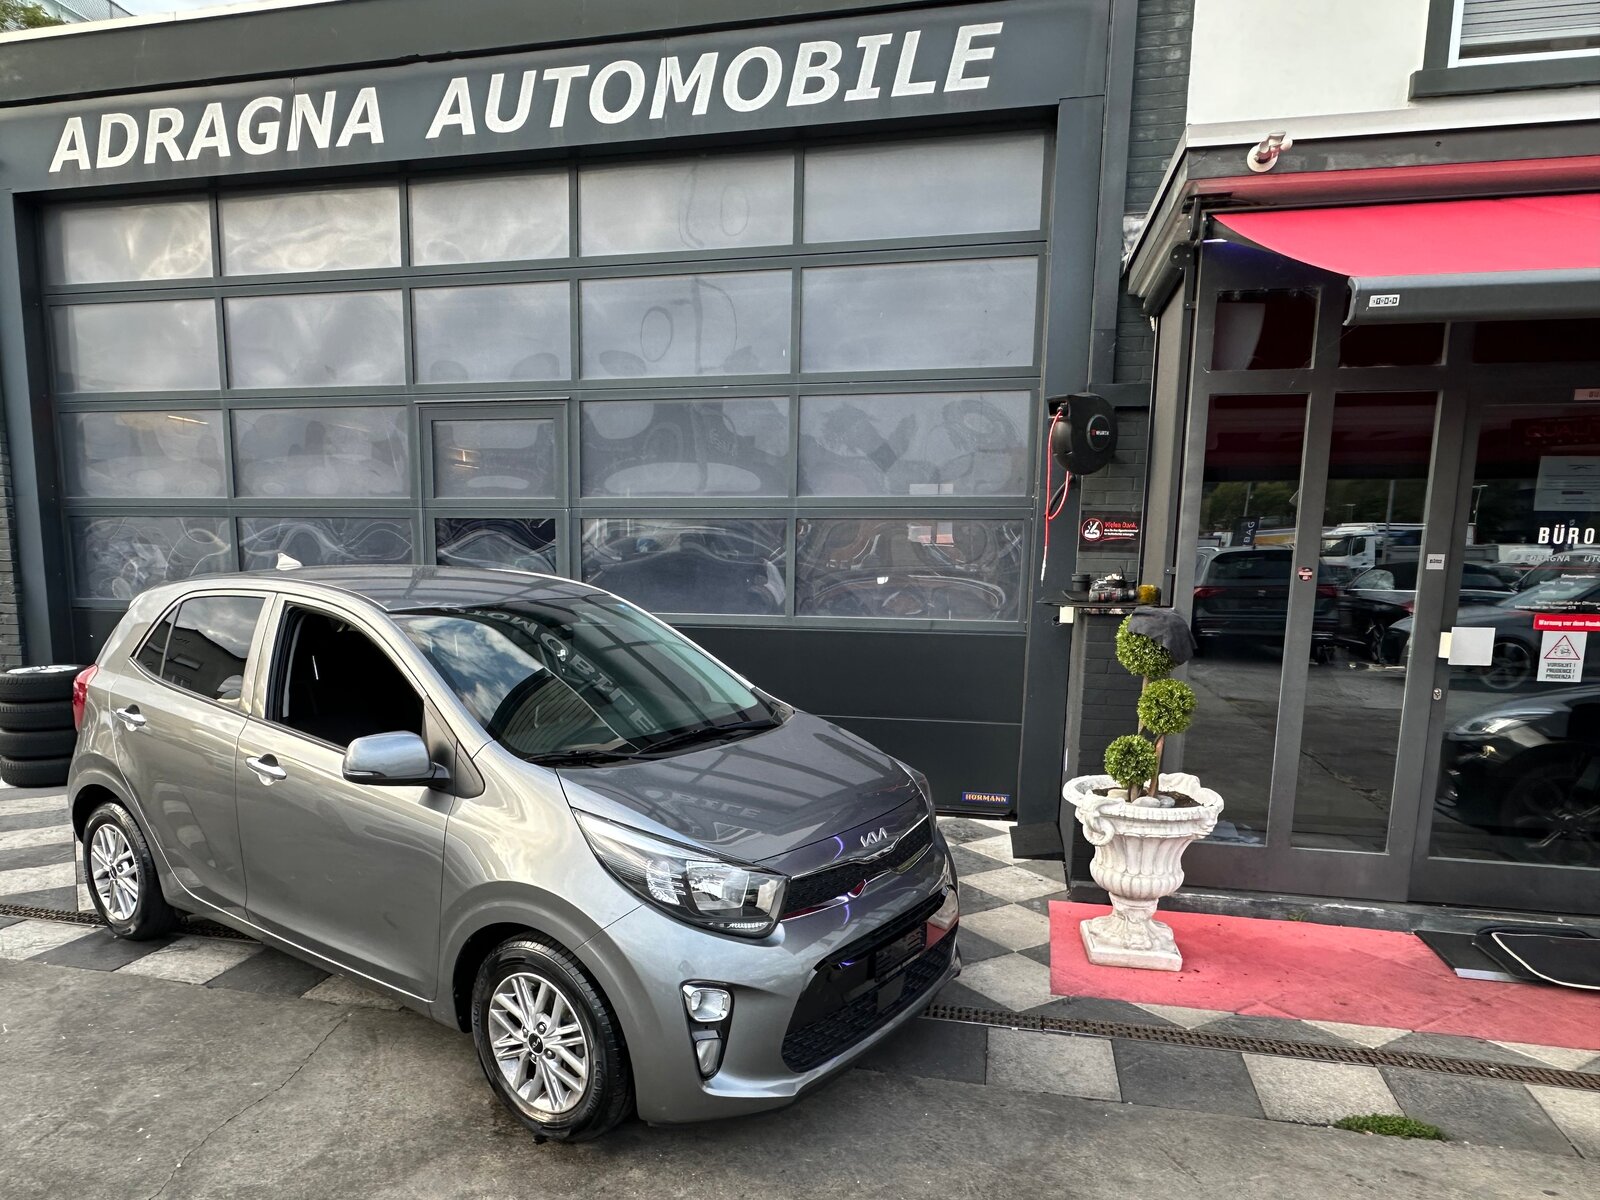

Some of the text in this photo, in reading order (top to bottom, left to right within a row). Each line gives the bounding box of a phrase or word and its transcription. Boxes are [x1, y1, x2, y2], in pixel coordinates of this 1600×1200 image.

[48, 21, 1005, 173] ADRAGNA AUTOMOBILE
[1537, 524, 1596, 545] BÜRO
